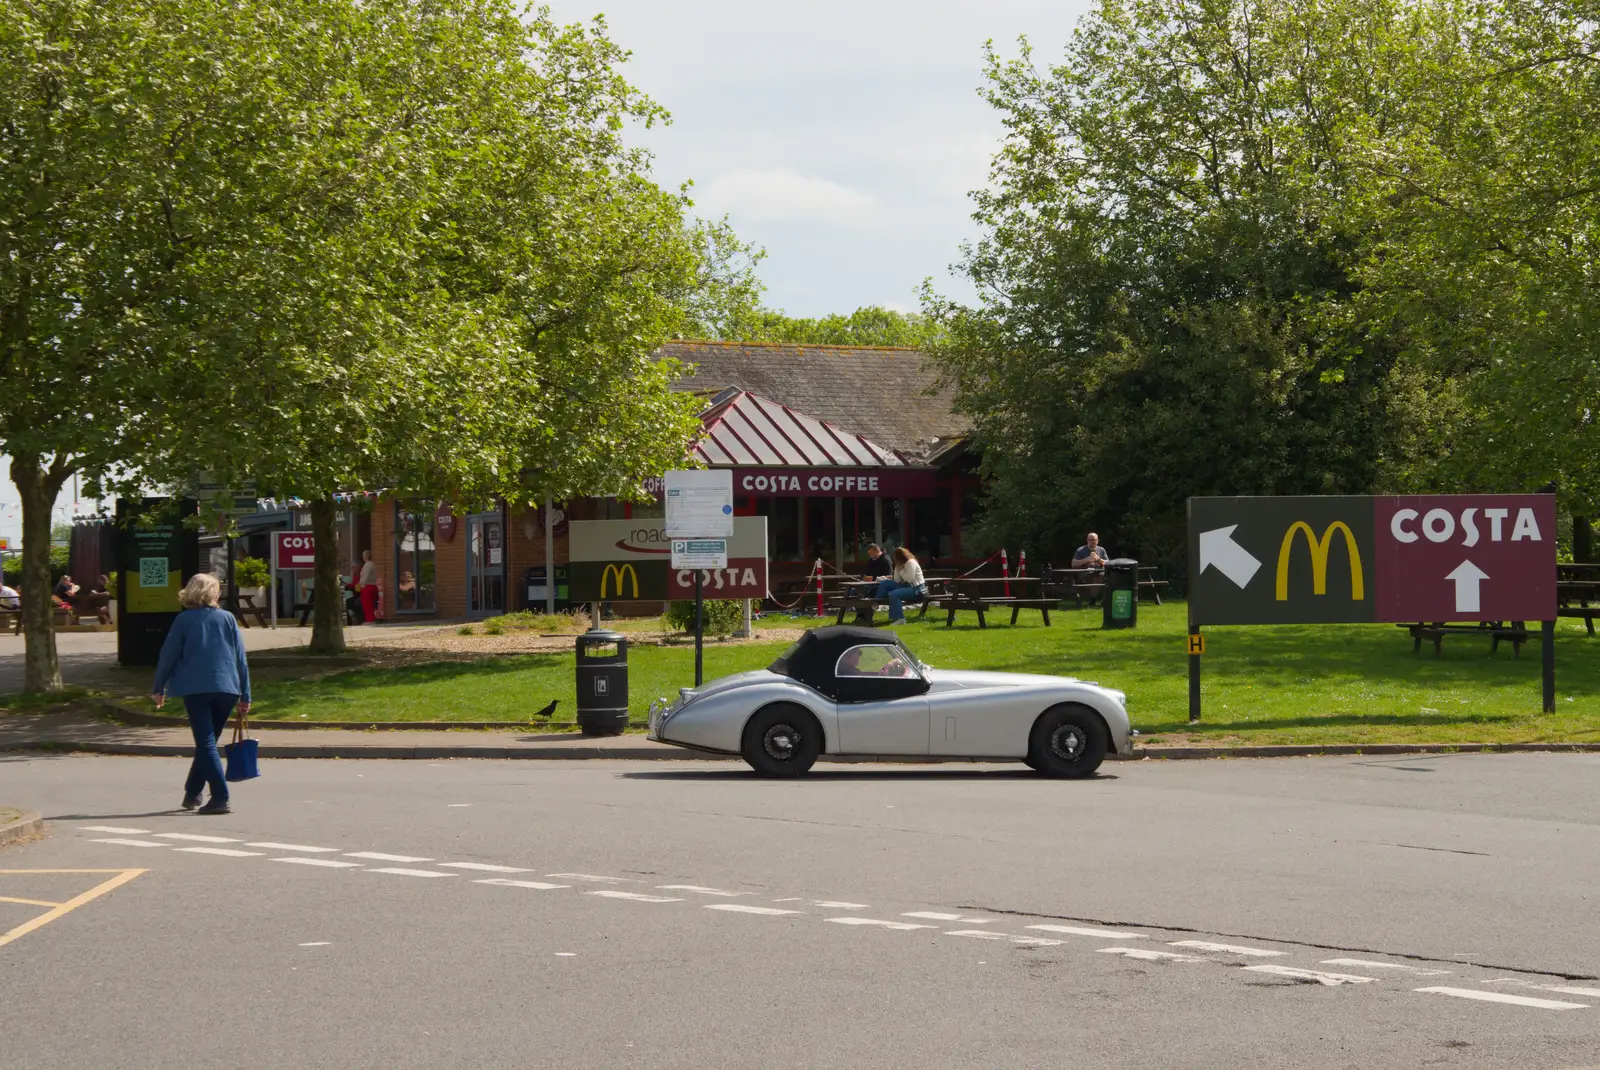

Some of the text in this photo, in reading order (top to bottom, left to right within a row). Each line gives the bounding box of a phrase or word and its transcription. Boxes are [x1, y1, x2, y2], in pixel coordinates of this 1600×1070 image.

[742, 475, 801, 492] COSTA
[807, 476, 879, 491] COFFEE
[1390, 507, 1542, 547] COSTA
[675, 542, 684, 554] P
[677, 568, 757, 589] COSTA
[1189, 637, 1202, 653] H
